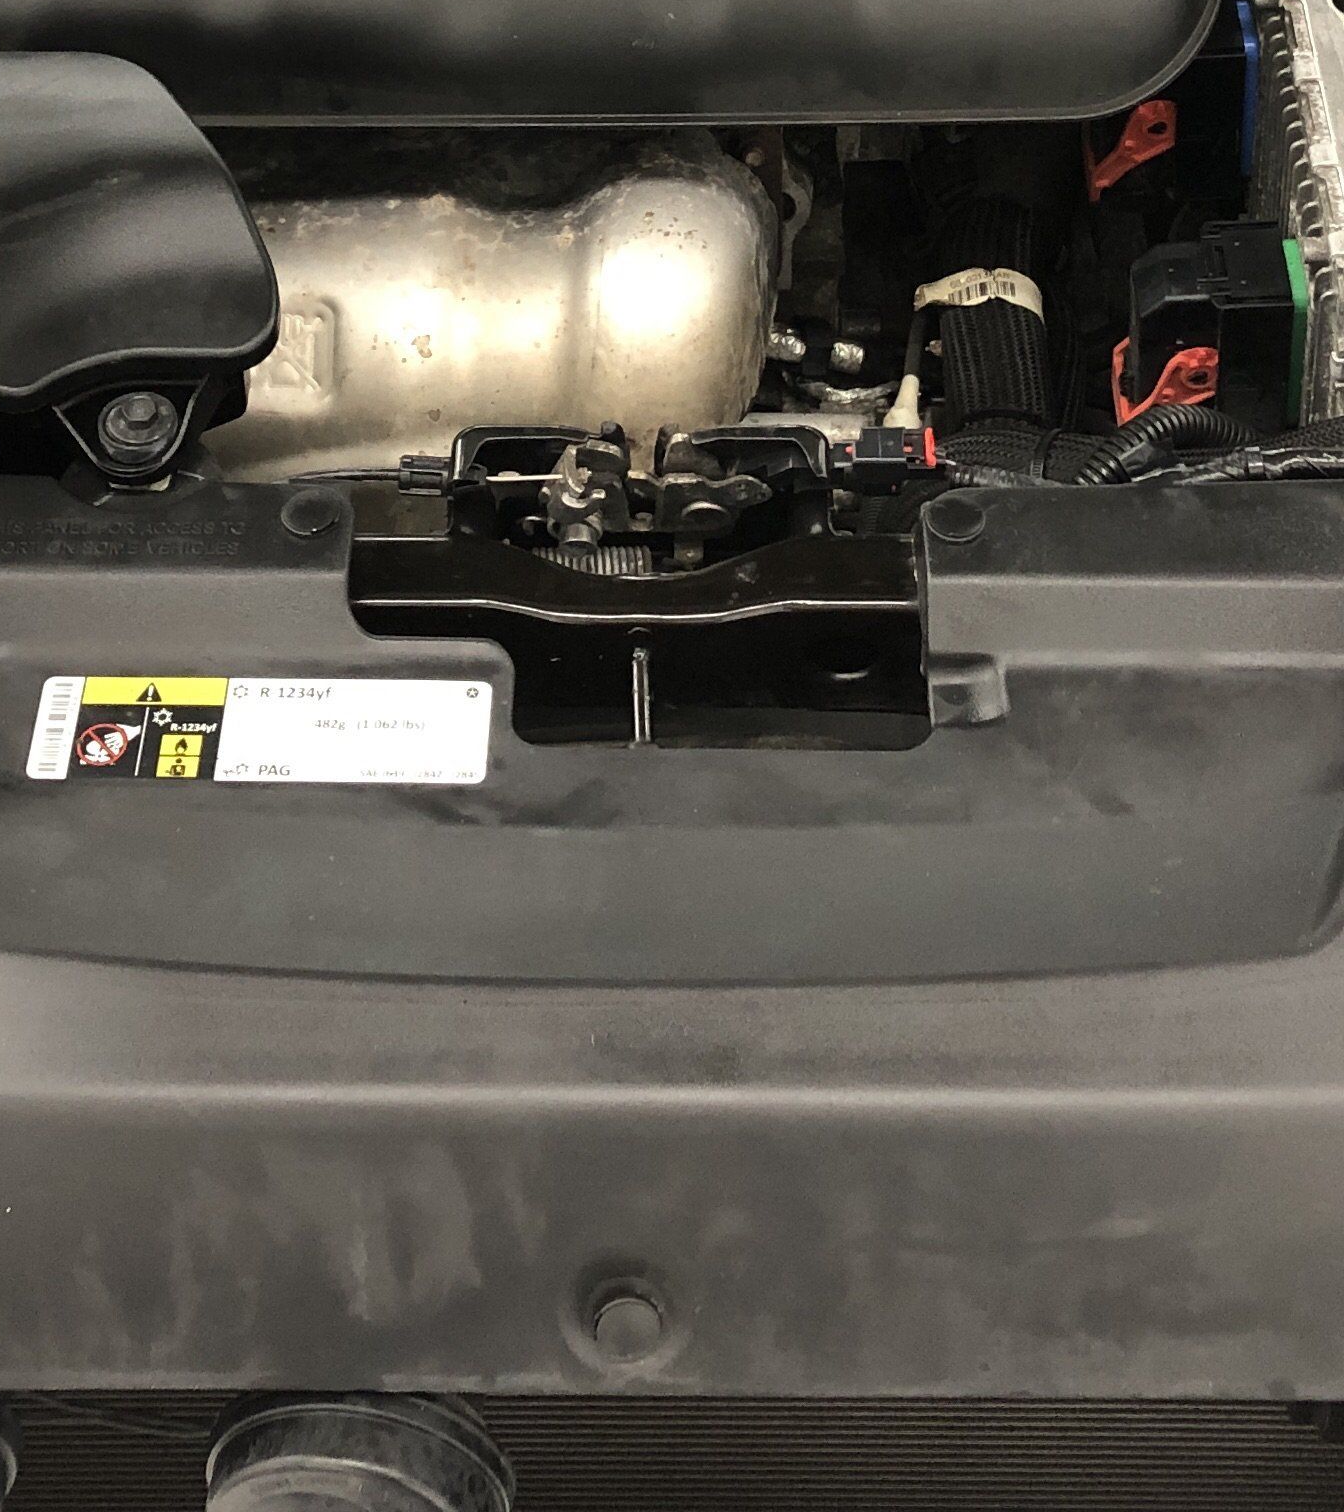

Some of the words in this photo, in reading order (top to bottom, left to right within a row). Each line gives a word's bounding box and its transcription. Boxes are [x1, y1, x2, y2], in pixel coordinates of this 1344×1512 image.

[141, 521, 216, 536] ACCESS
[145, 540, 240, 556] VEHICLES
[169, 722, 218, 734] R-1234yf
[314, 719, 346, 731] 482g
[258, 764, 291, 776] PAG
